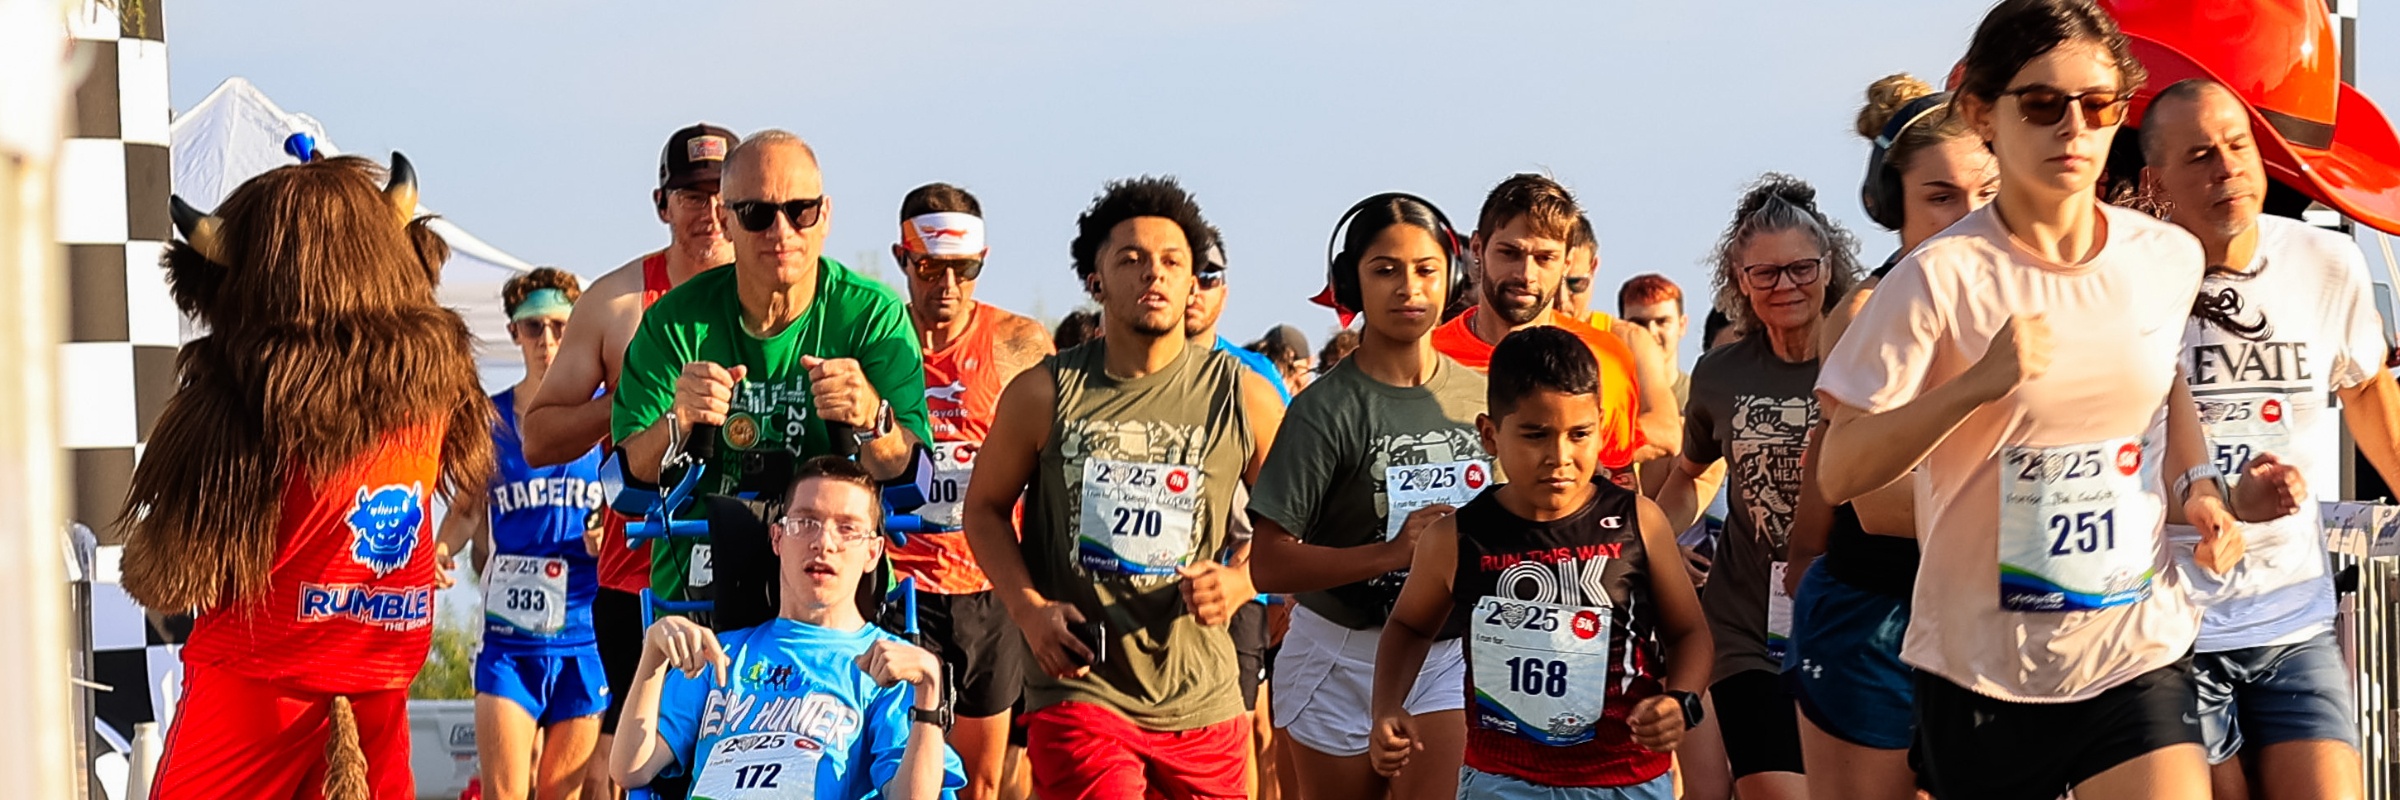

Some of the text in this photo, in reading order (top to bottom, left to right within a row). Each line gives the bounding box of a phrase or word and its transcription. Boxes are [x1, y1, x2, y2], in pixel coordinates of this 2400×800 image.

[2187, 341, 2312, 386] EVATE
[928, 409, 968, 419] oyote
[1773, 446, 1788, 455] THE
[1468, 470, 1482, 482] 5K
[494, 477, 603, 515] RACERS
[1112, 507, 1162, 537] 270
[2049, 510, 2115, 557] 251
[1481, 542, 1623, 571] RUN THIS WAY
[1496, 555, 1614, 608] OK
[301, 586, 430, 621] RUMBLE
[507, 587, 546, 612] 333
[385, 622, 405, 632] THE
[1576, 617, 1595, 632] 5K
[1506, 656, 1568, 698] 168
[750, 692, 860, 752] HUNTER
[735, 763, 782, 790] 172
